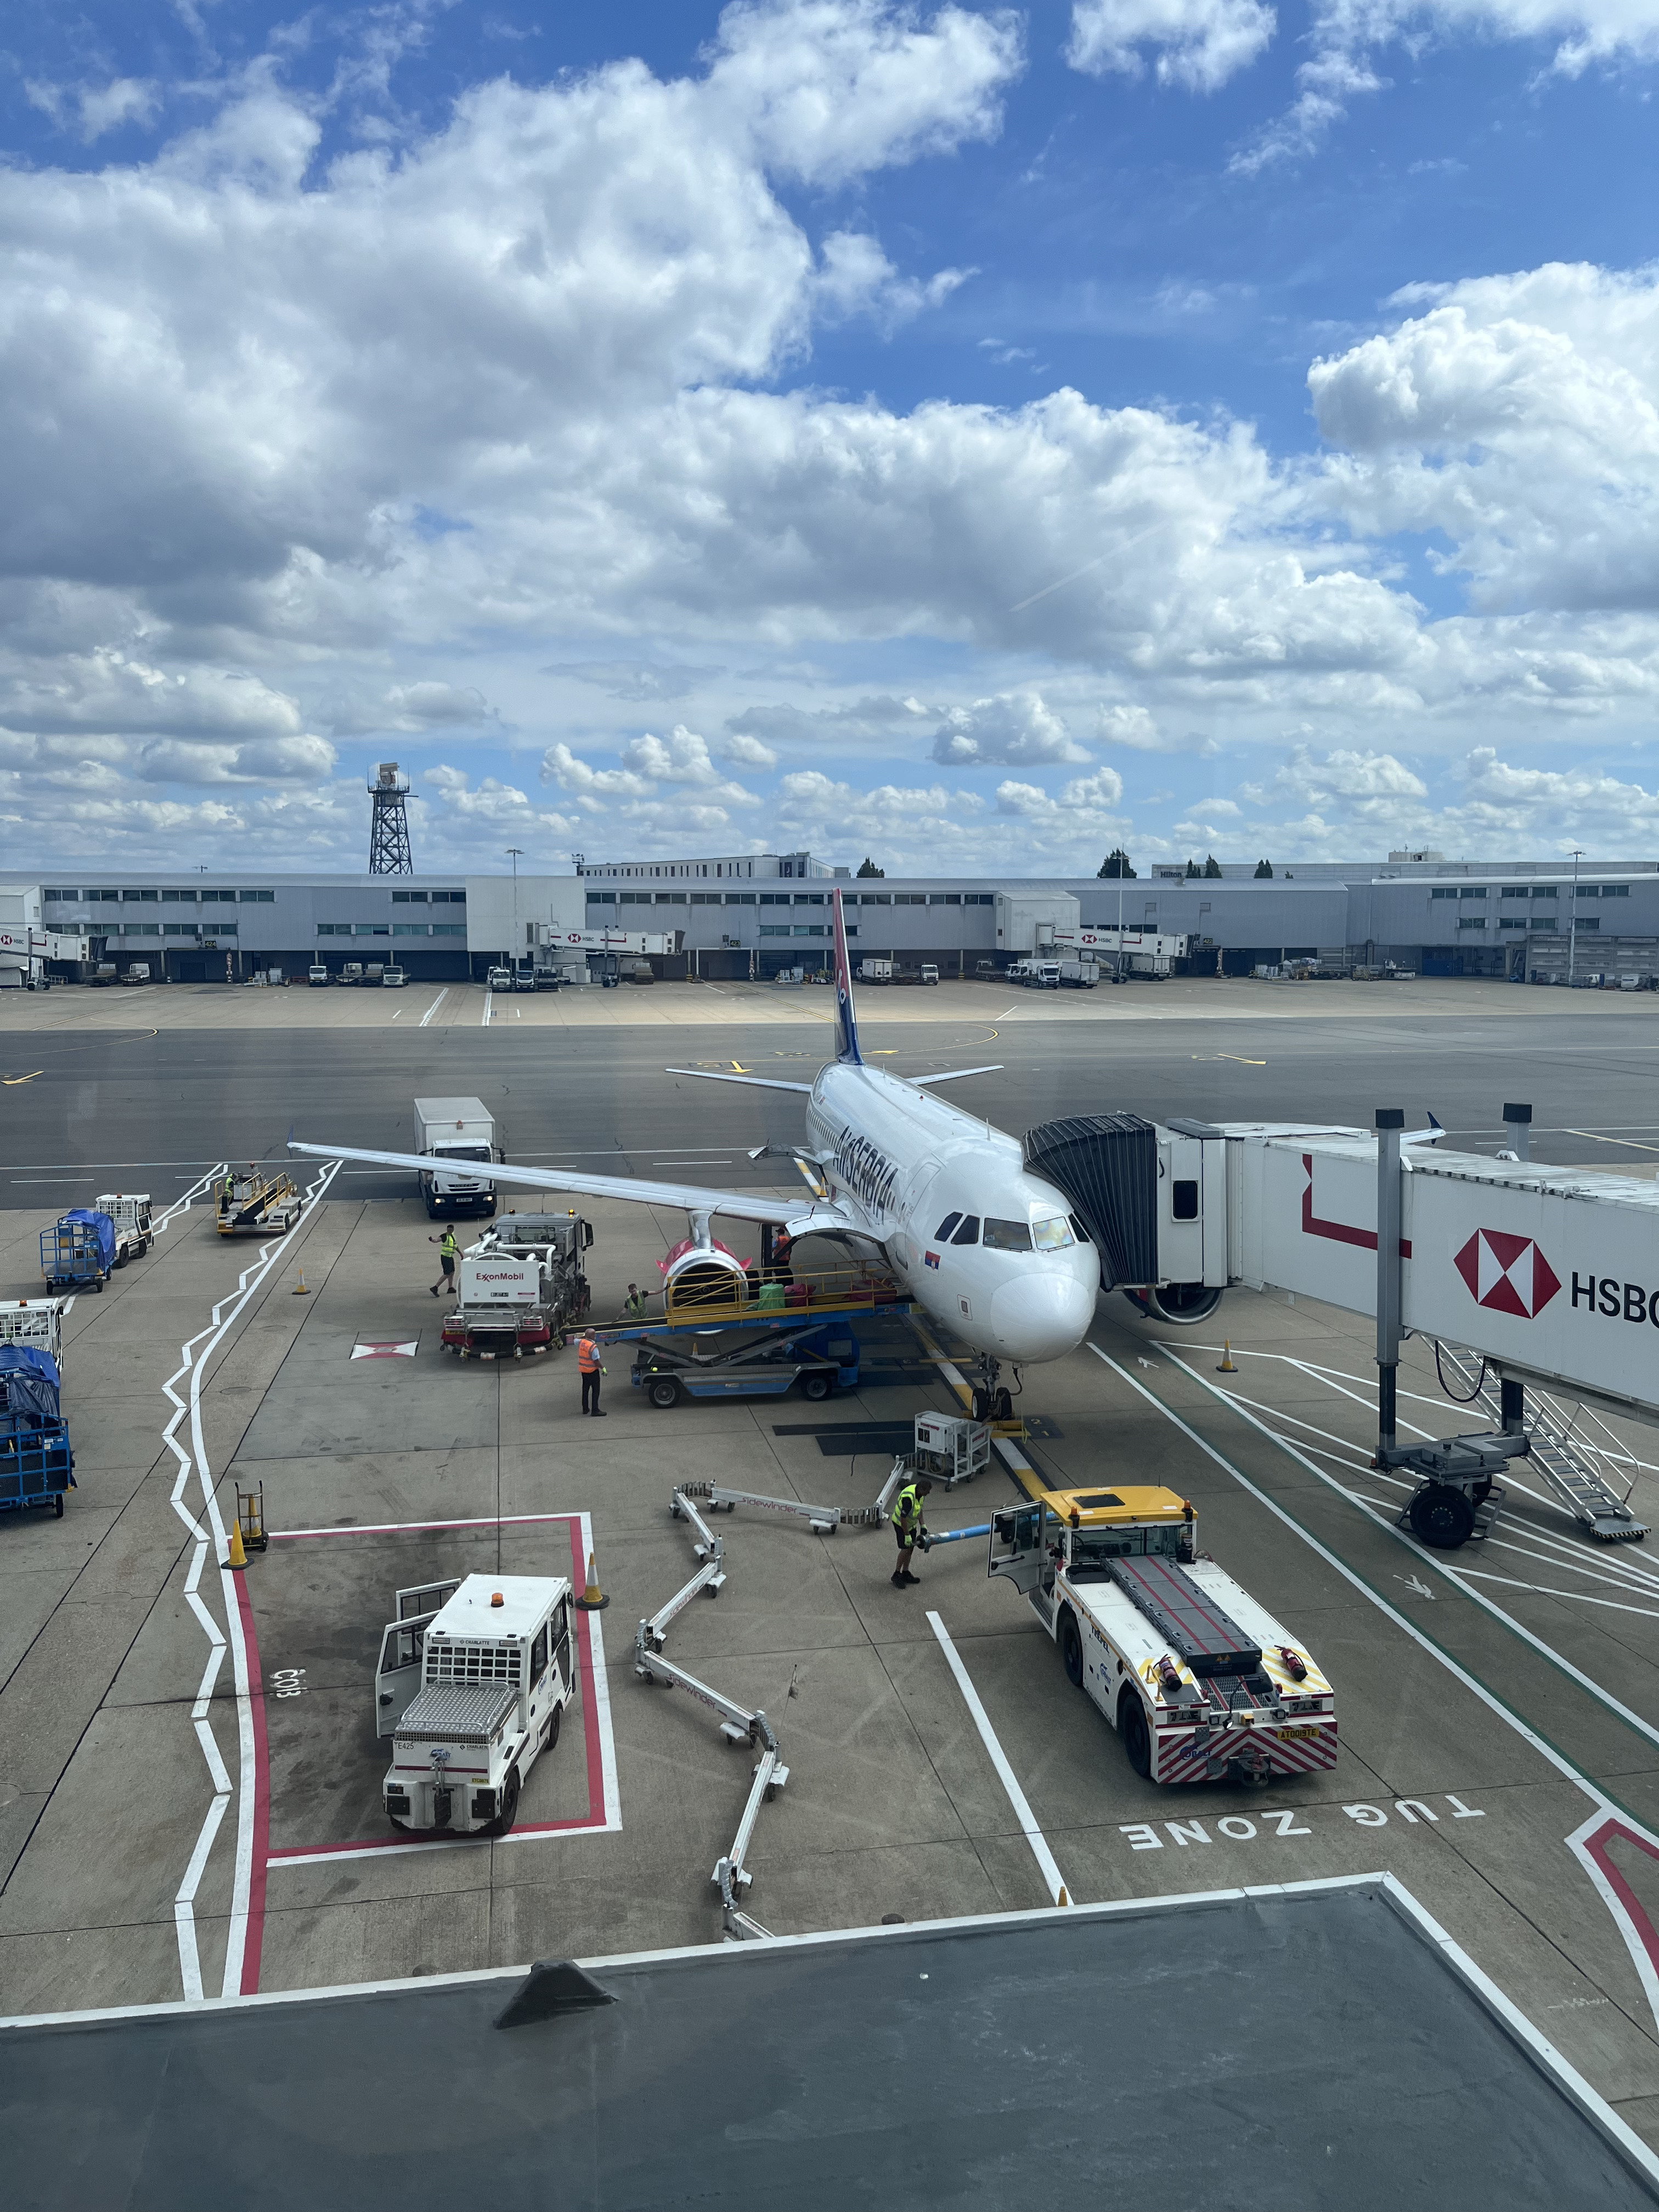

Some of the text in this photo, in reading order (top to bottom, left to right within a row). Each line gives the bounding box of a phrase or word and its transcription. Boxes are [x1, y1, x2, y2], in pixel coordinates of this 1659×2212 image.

[476, 1273, 524, 1283] ExxonMobil
[394, 1741, 414, 1750] TE425
[1119, 1795, 1486, 1850] TUG ZONE
